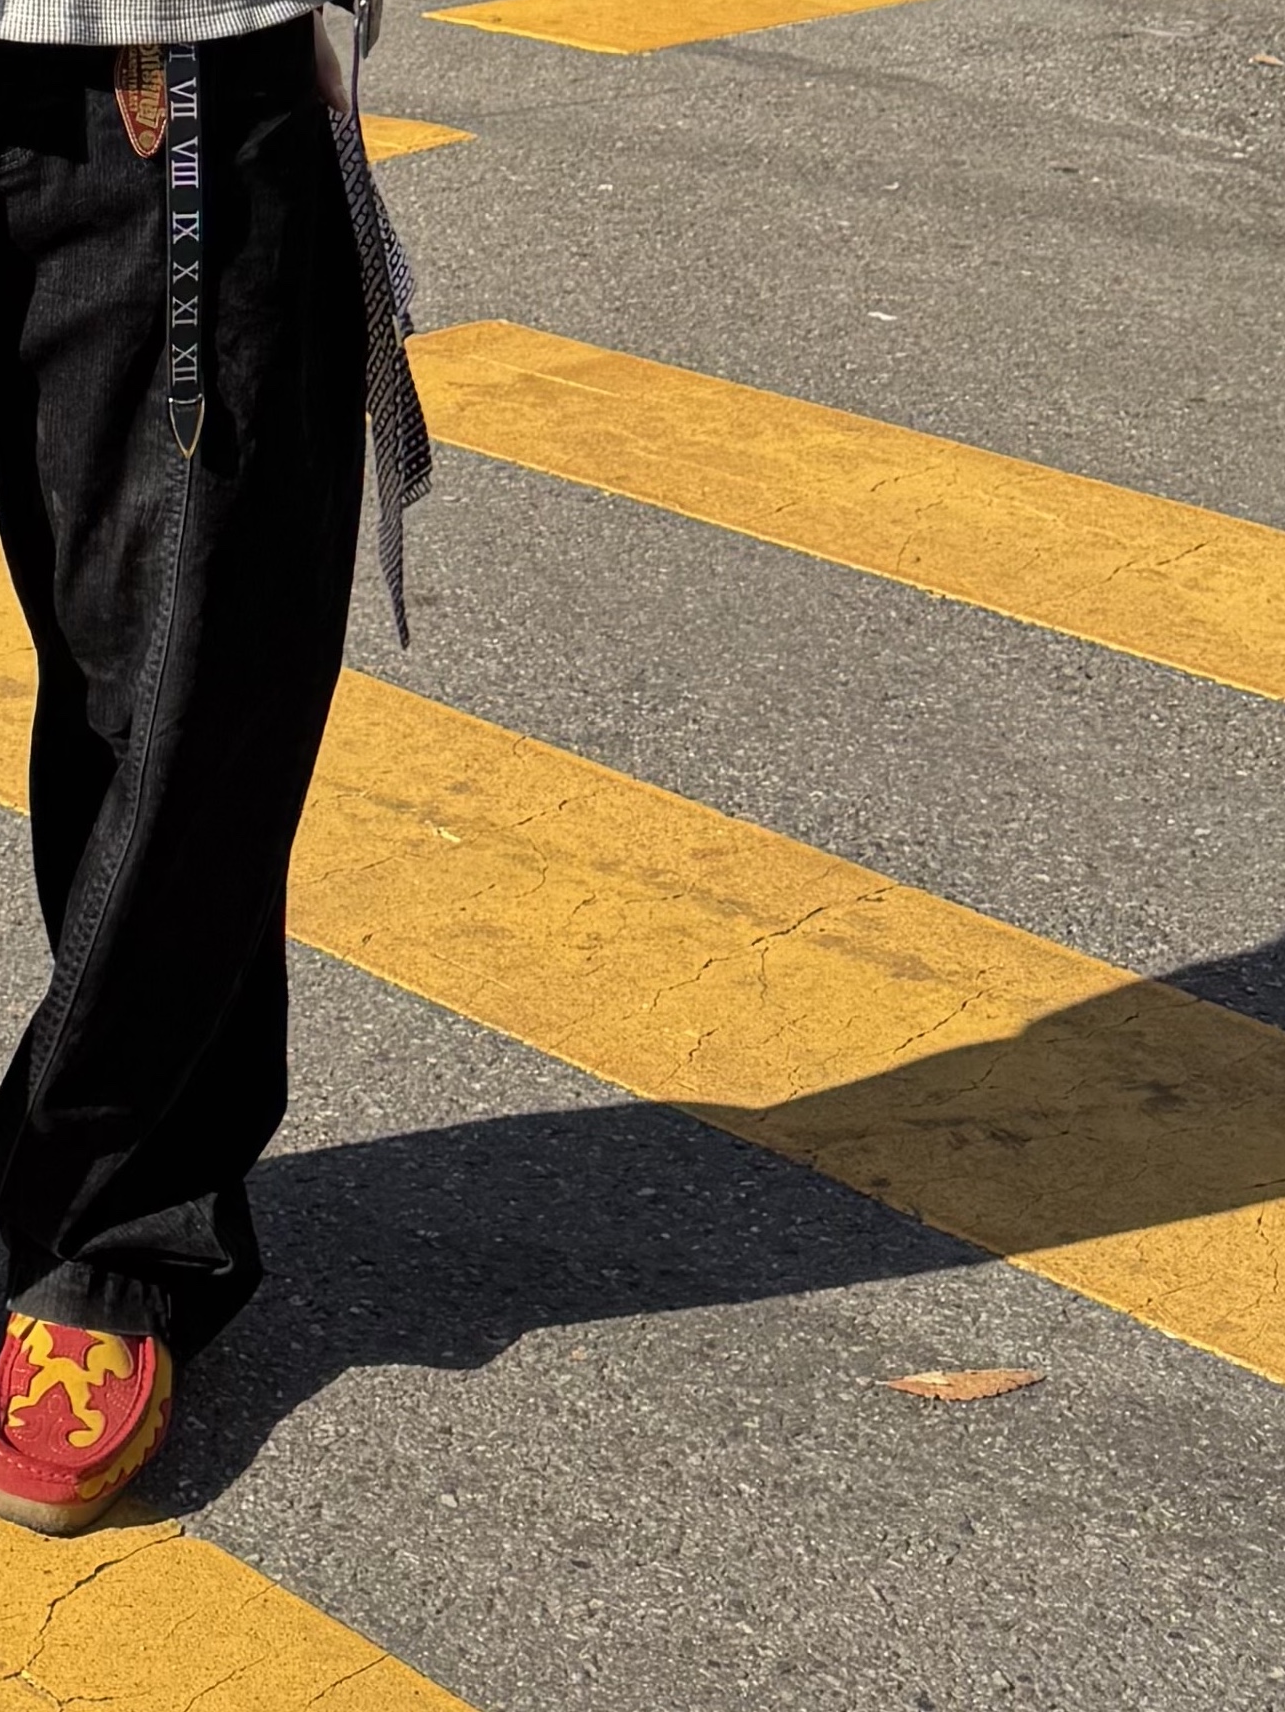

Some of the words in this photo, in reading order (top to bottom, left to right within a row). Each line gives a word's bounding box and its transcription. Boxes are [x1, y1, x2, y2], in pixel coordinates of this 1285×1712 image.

[170, 76, 198, 122] VII
[171, 136, 199, 190] VIII
[172, 210, 200, 245] IX
[172, 260, 199, 285] X
[172, 295, 198, 329] XI
[171, 342, 198, 387] XII
